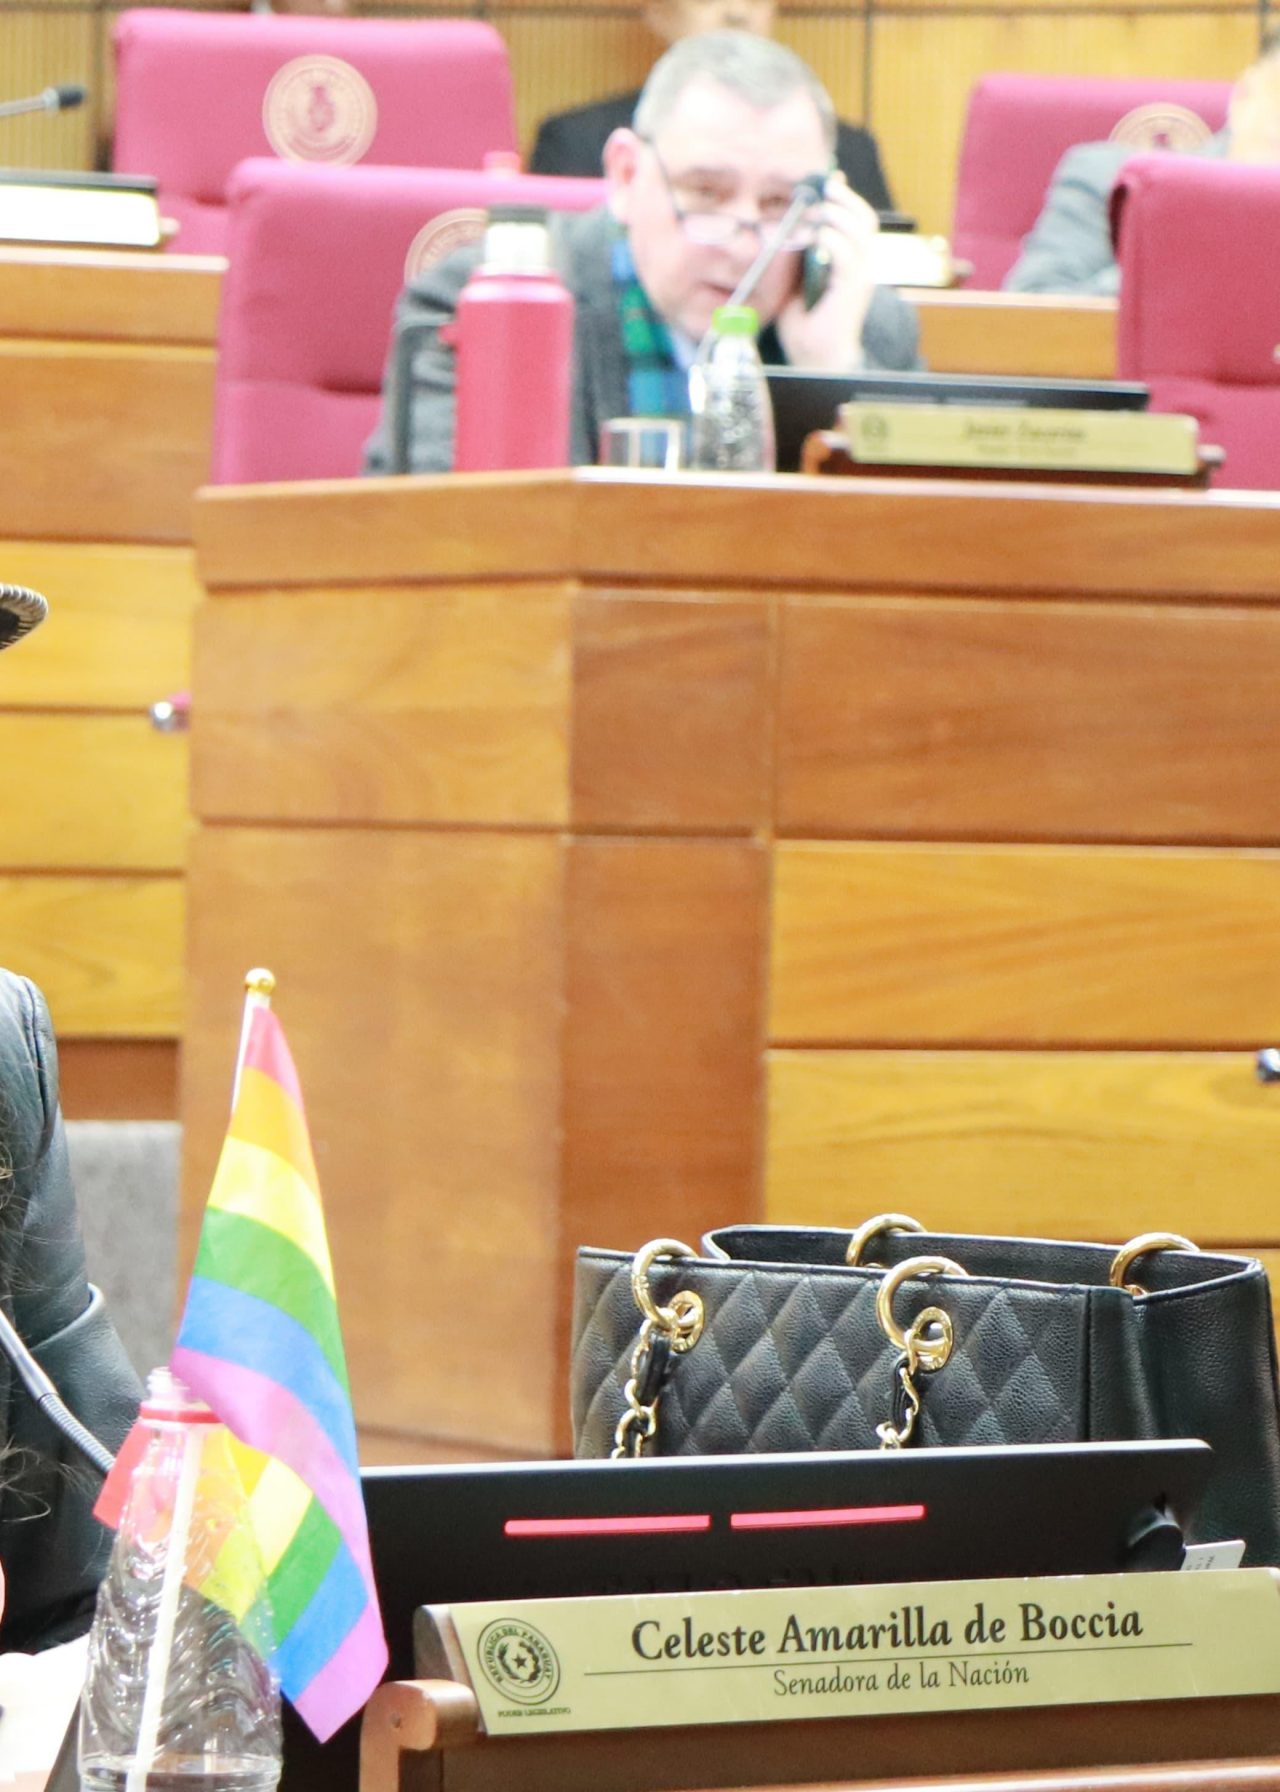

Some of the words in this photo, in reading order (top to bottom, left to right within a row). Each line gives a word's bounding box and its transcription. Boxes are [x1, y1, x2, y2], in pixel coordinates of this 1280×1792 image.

[631, 1616, 766, 1661] Celeste
[777, 1605, 952, 1654] Amarilla
[964, 1602, 1006, 1645] de
[1018, 1600, 1143, 1642] Boccia
[773, 1665, 879, 1697] Senadora
[887, 1662, 911, 1690] de
[919, 1661, 941, 1689] la
[948, 1660, 1030, 1688] Nación
